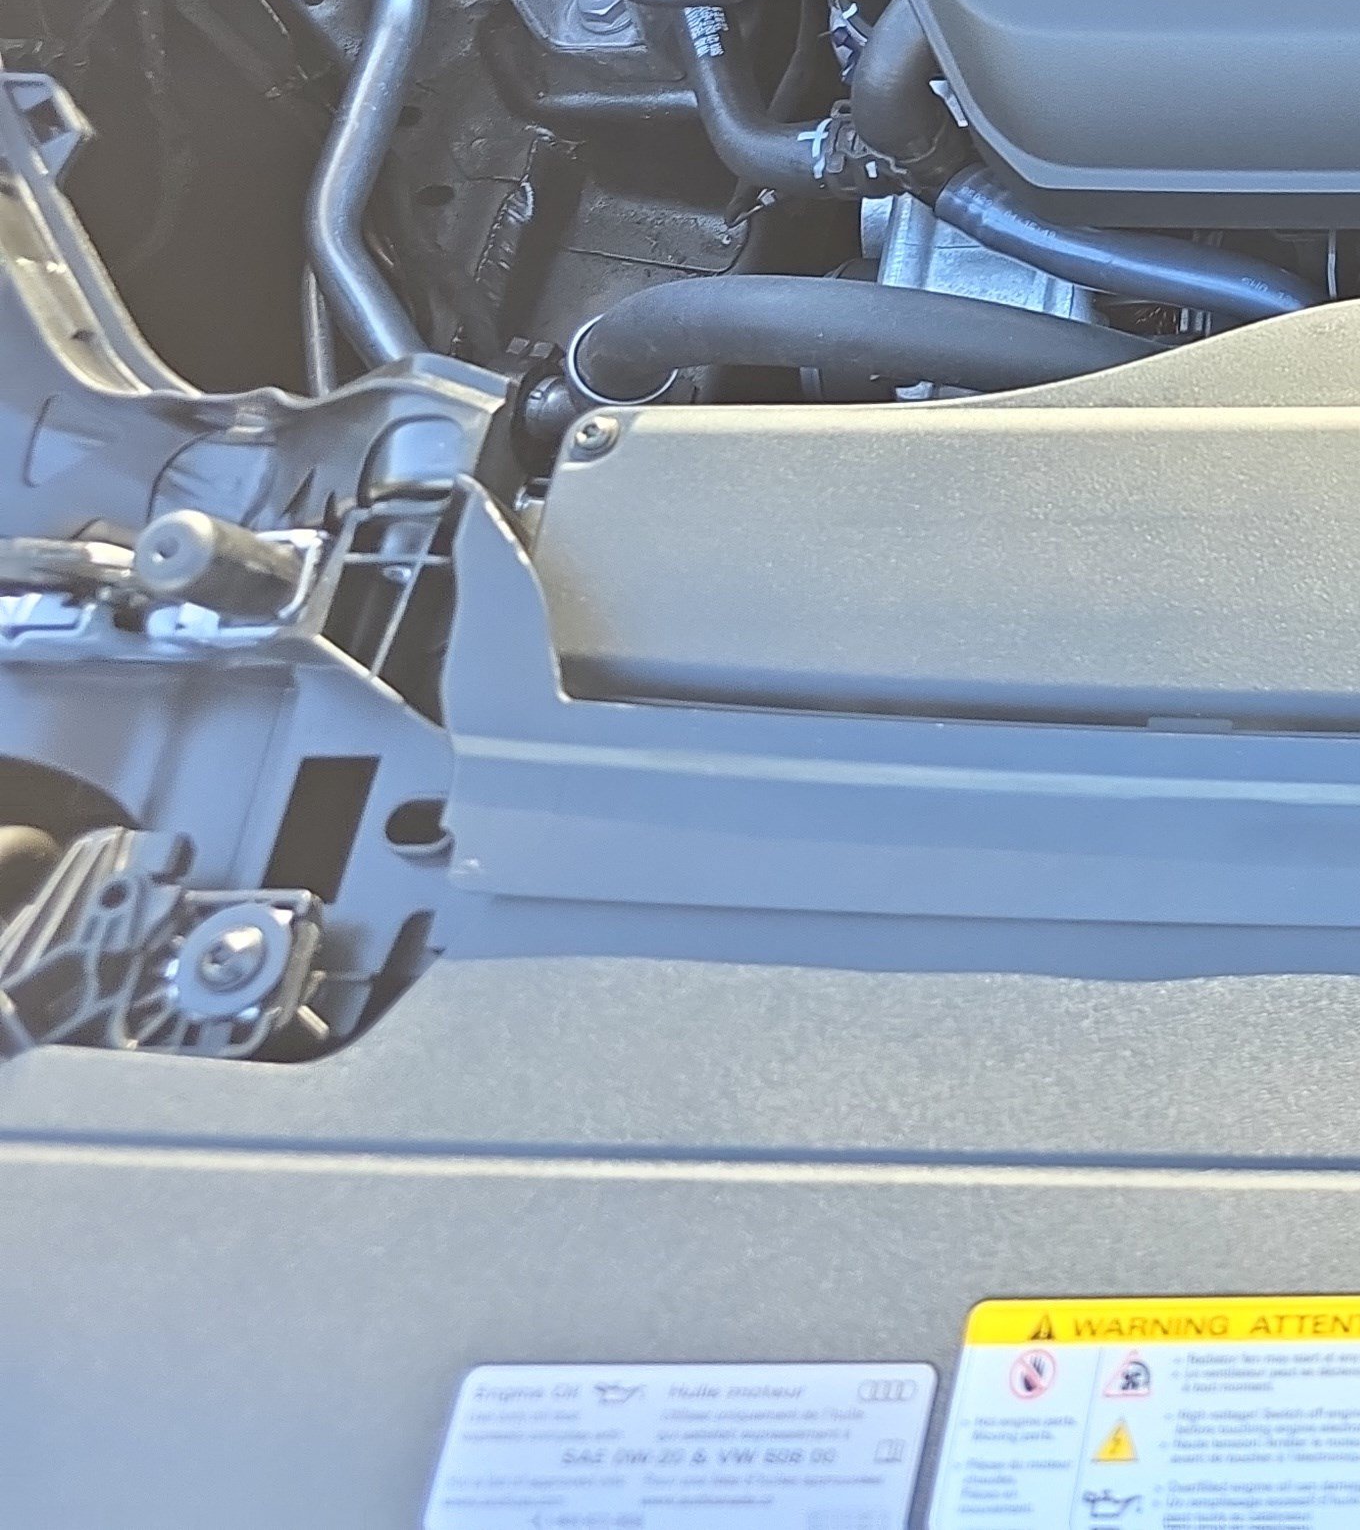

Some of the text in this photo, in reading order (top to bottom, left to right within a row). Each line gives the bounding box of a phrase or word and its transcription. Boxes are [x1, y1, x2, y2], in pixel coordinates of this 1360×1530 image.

[1072, 1313, 1231, 1337] WARNING
[561, 1448, 607, 1465] SAE
[717, 1447, 759, 1465] VW
